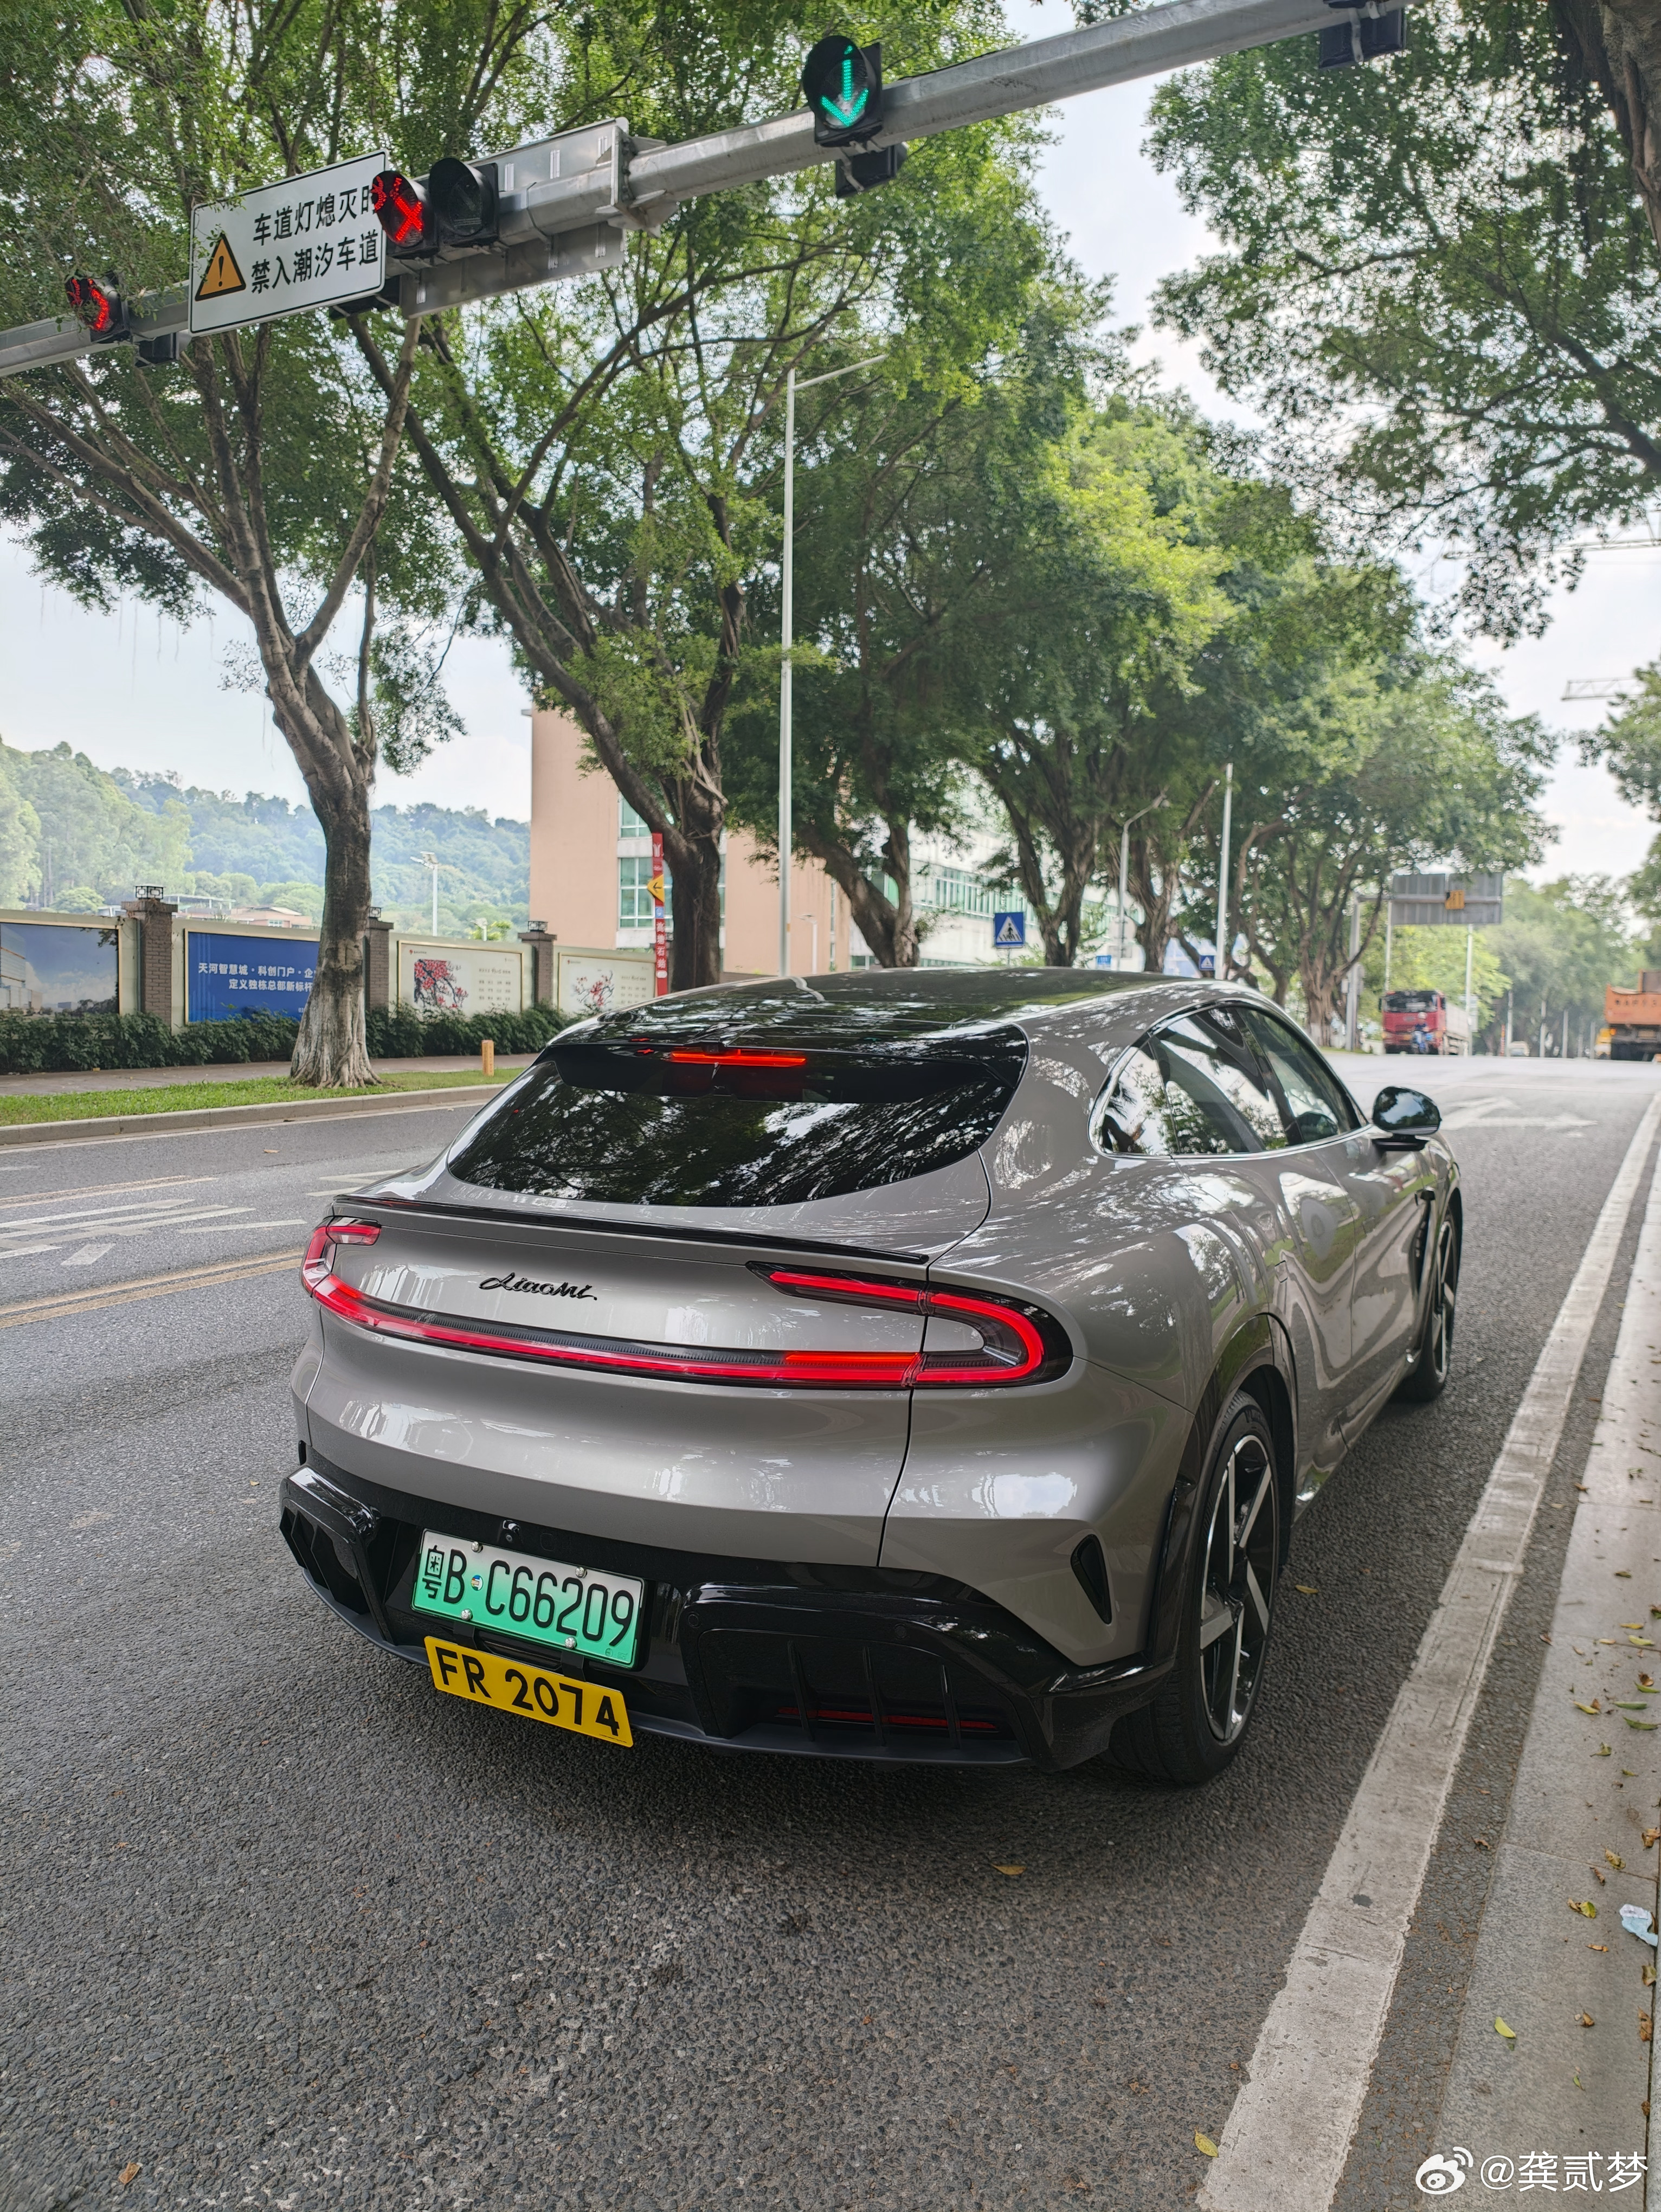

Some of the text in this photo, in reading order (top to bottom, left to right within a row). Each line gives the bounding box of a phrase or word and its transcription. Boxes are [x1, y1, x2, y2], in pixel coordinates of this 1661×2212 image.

[251, 229, 378, 294] 禁入潮汐车道
[434, 1646, 620, 1737] FR 2074
